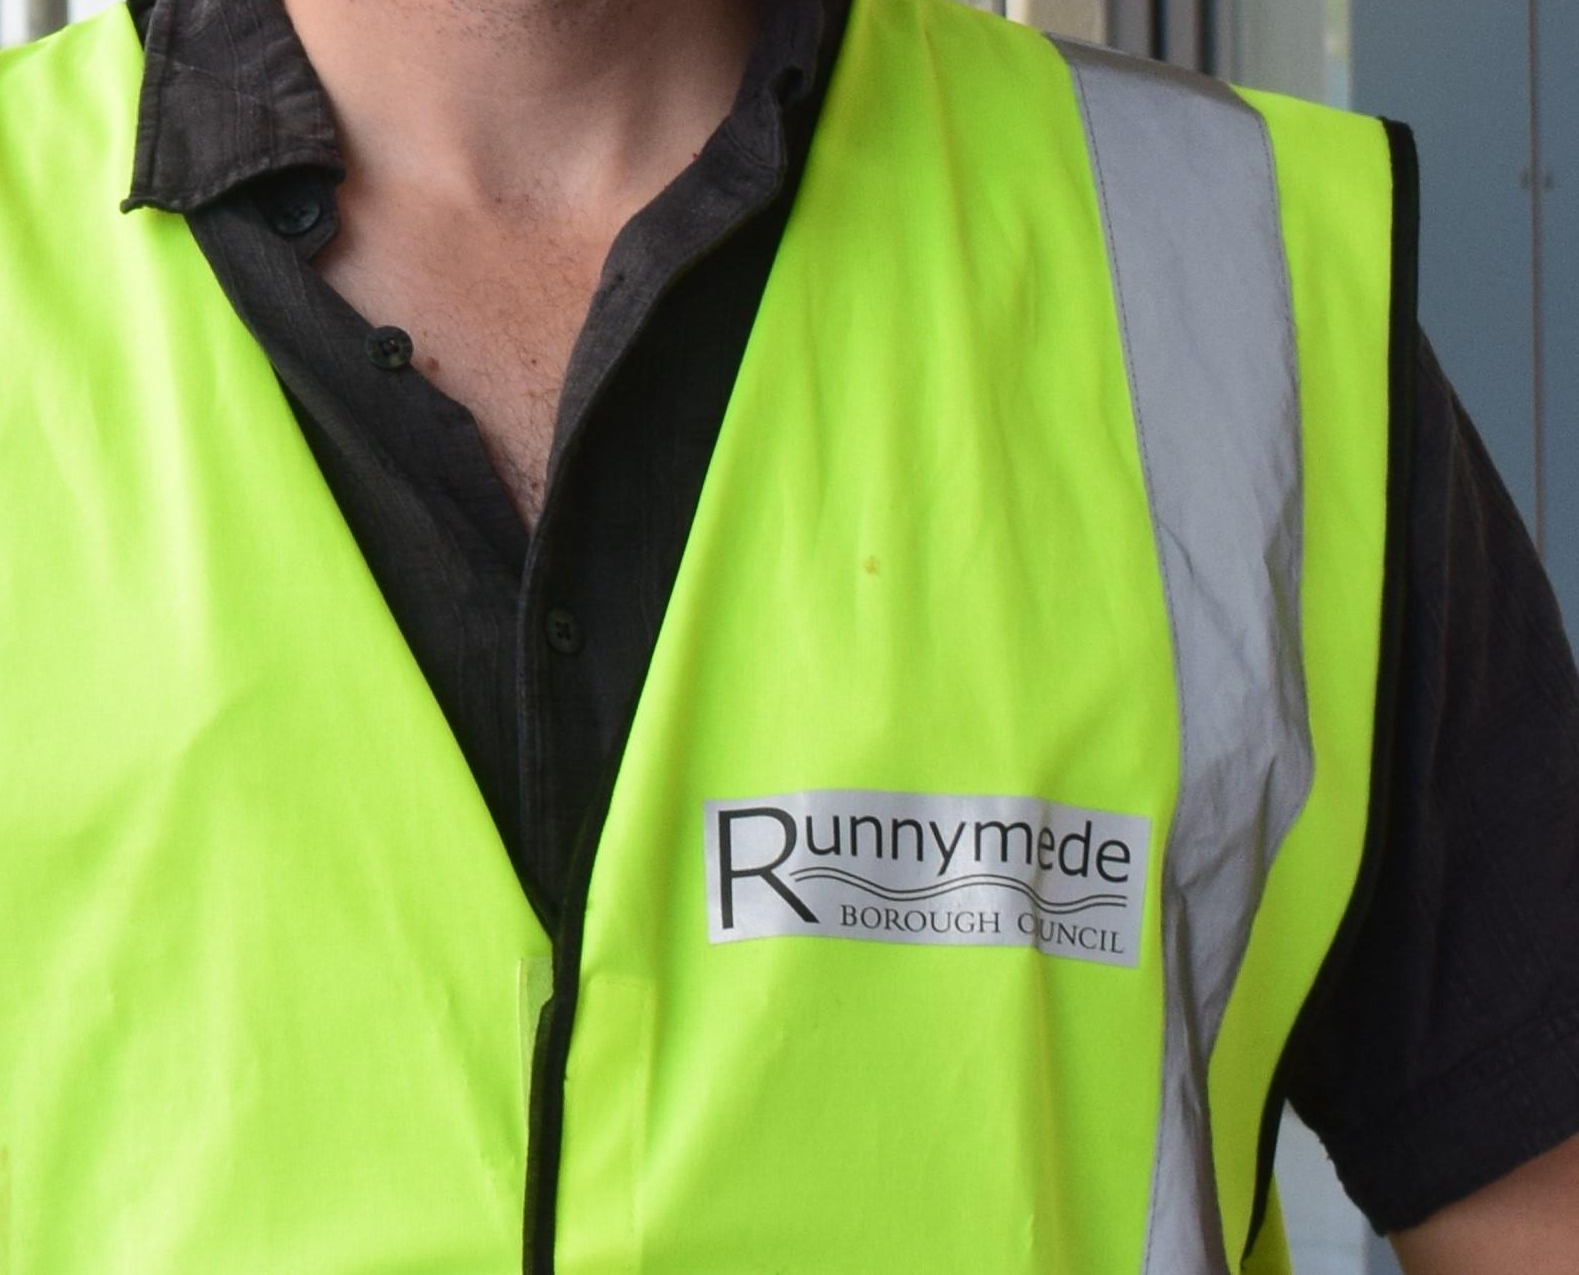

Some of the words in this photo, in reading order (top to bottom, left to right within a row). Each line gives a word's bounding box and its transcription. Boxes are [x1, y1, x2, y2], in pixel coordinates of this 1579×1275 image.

[717, 806, 1132, 929] Runnymede
[840, 905, 1000, 934] BOROUGH
[1017, 912, 1124, 954] CUNCIL
